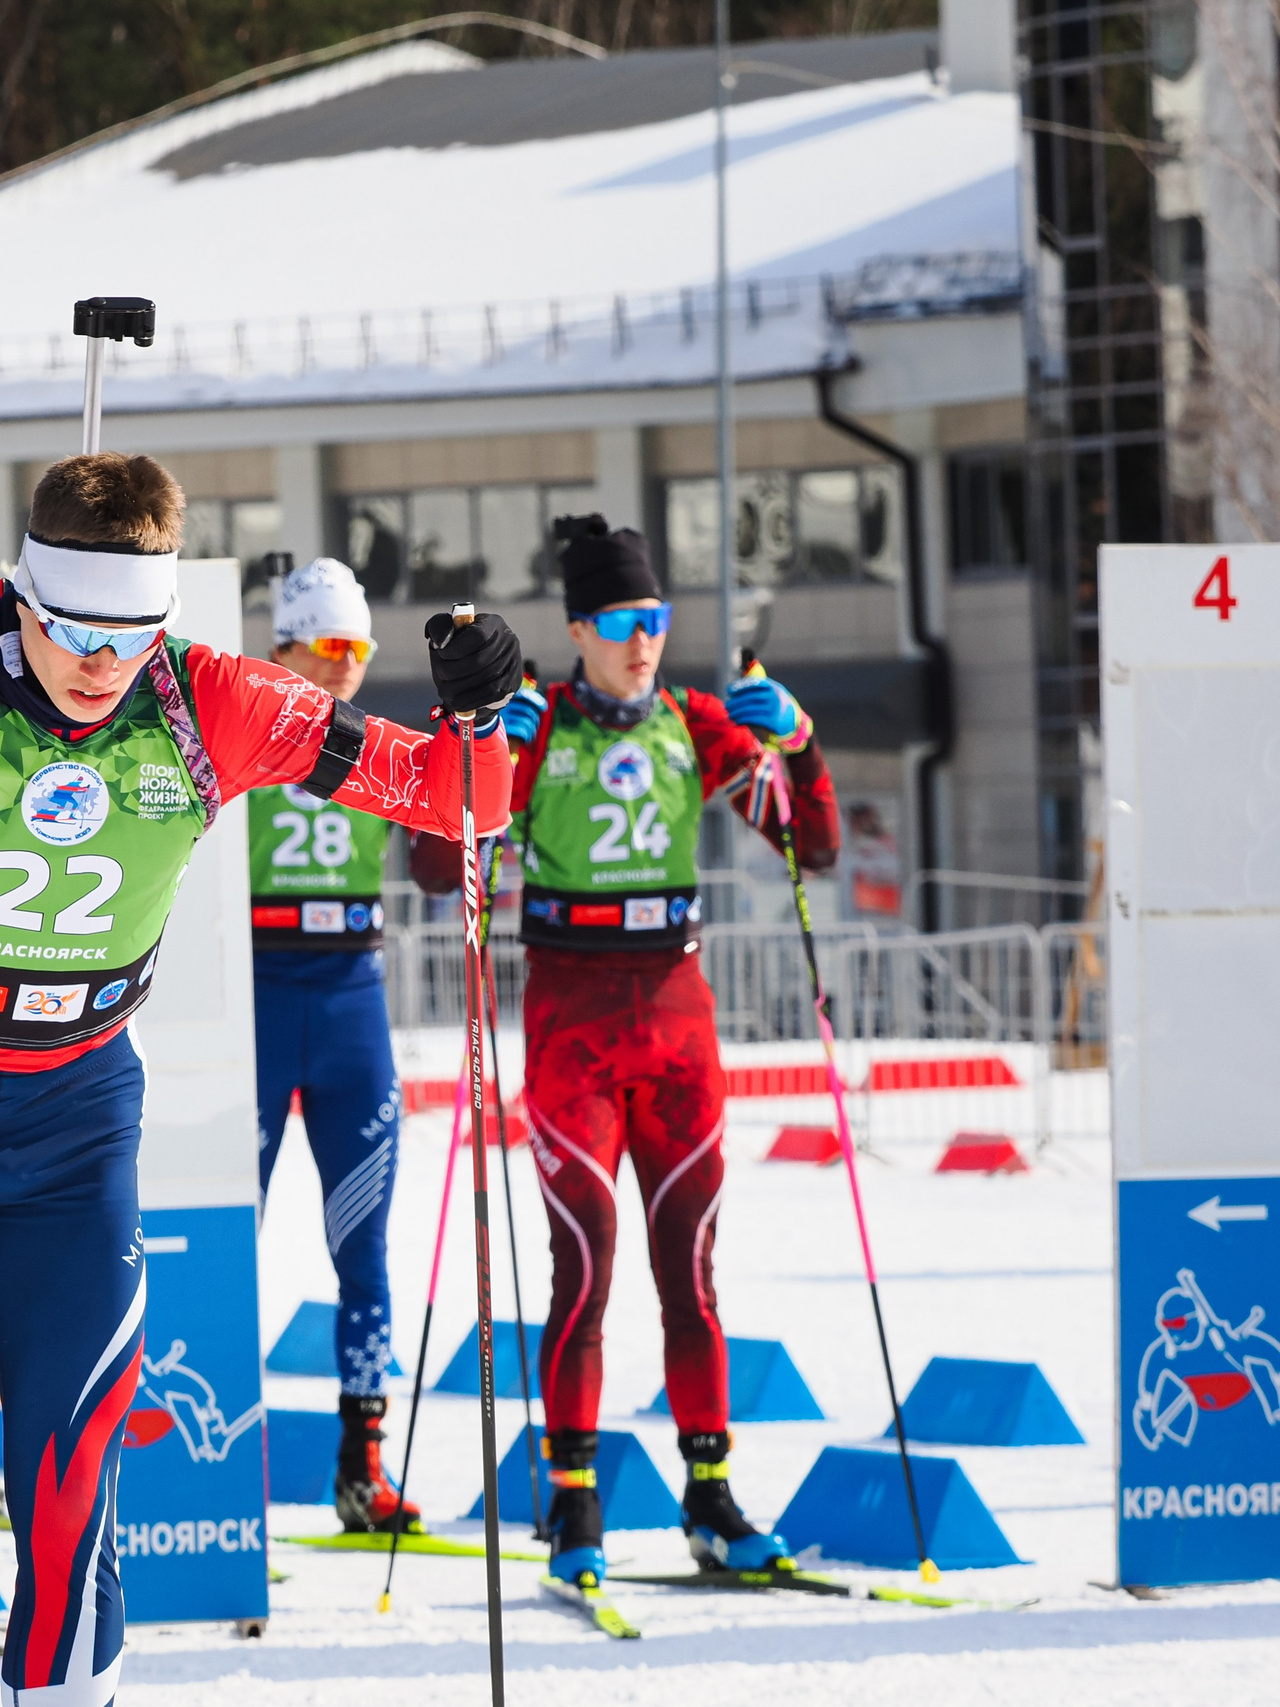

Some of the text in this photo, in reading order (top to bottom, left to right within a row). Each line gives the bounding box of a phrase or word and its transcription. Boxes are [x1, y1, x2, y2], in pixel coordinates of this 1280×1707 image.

[1194, 556, 1237, 620] 4
[462, 724, 471, 741] TCS
[31, 763, 103, 786] ПЕРВЕНСТВО РОССИИ
[139, 763, 181, 780] СПОРТ
[139, 791, 190, 806] ЖИЗНИ
[272, 811, 352, 868] 28
[588, 801, 671, 863] 24
[462, 804, 478, 956] SWIX
[471, 1018, 480, 1055] TRIAC
[473, 1074, 482, 1110] AERO
